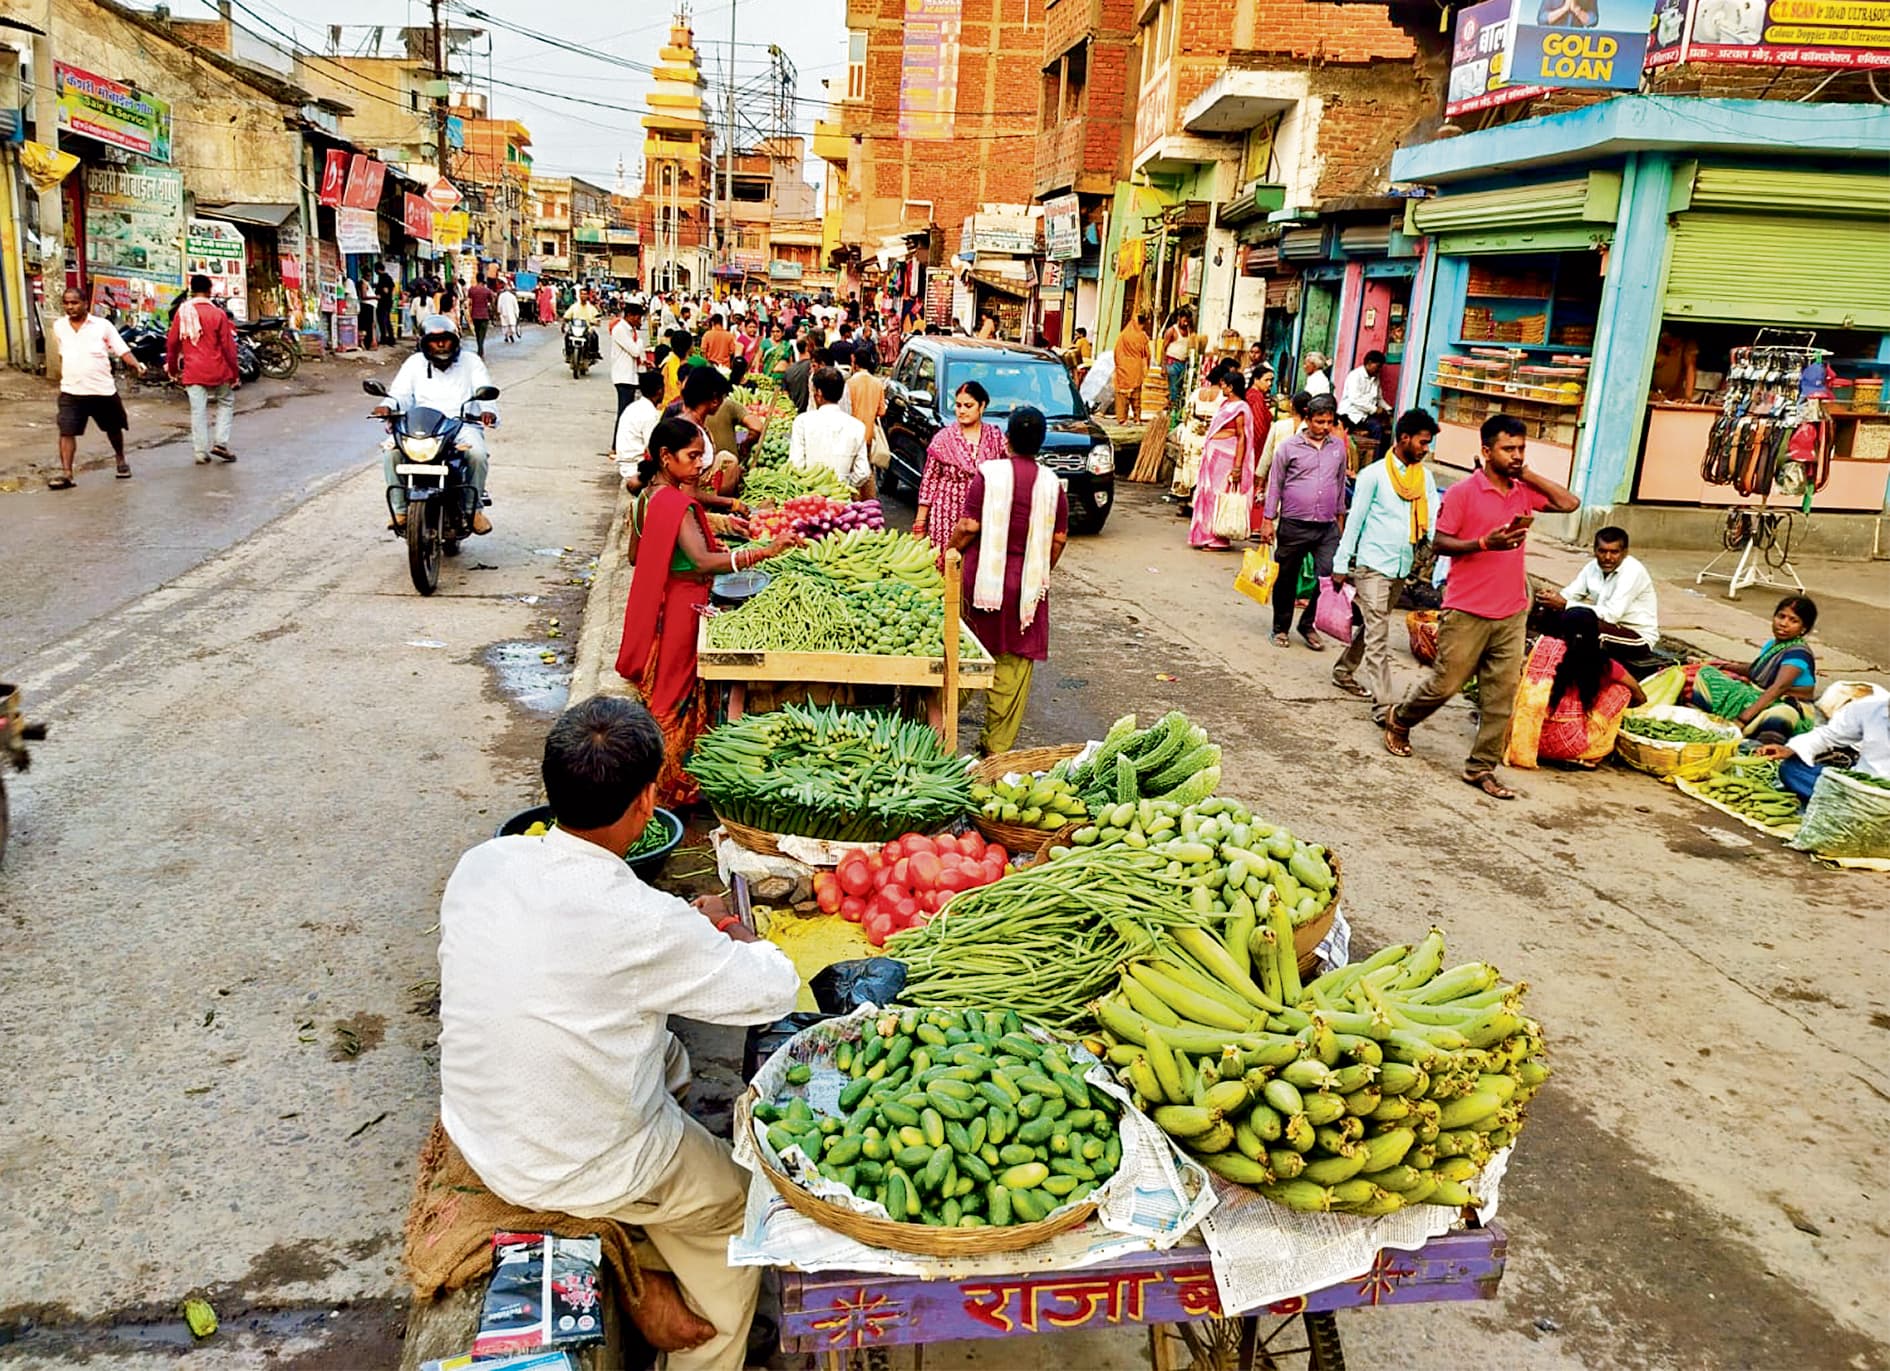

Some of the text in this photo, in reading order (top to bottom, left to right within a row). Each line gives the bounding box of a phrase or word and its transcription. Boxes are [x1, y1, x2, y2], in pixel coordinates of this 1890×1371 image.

[1848, 7, 1890, 22] ULTRASOU
[1540, 33, 1618, 81] GOLD LOAN
[960, 1271, 1164, 1332] राजा
